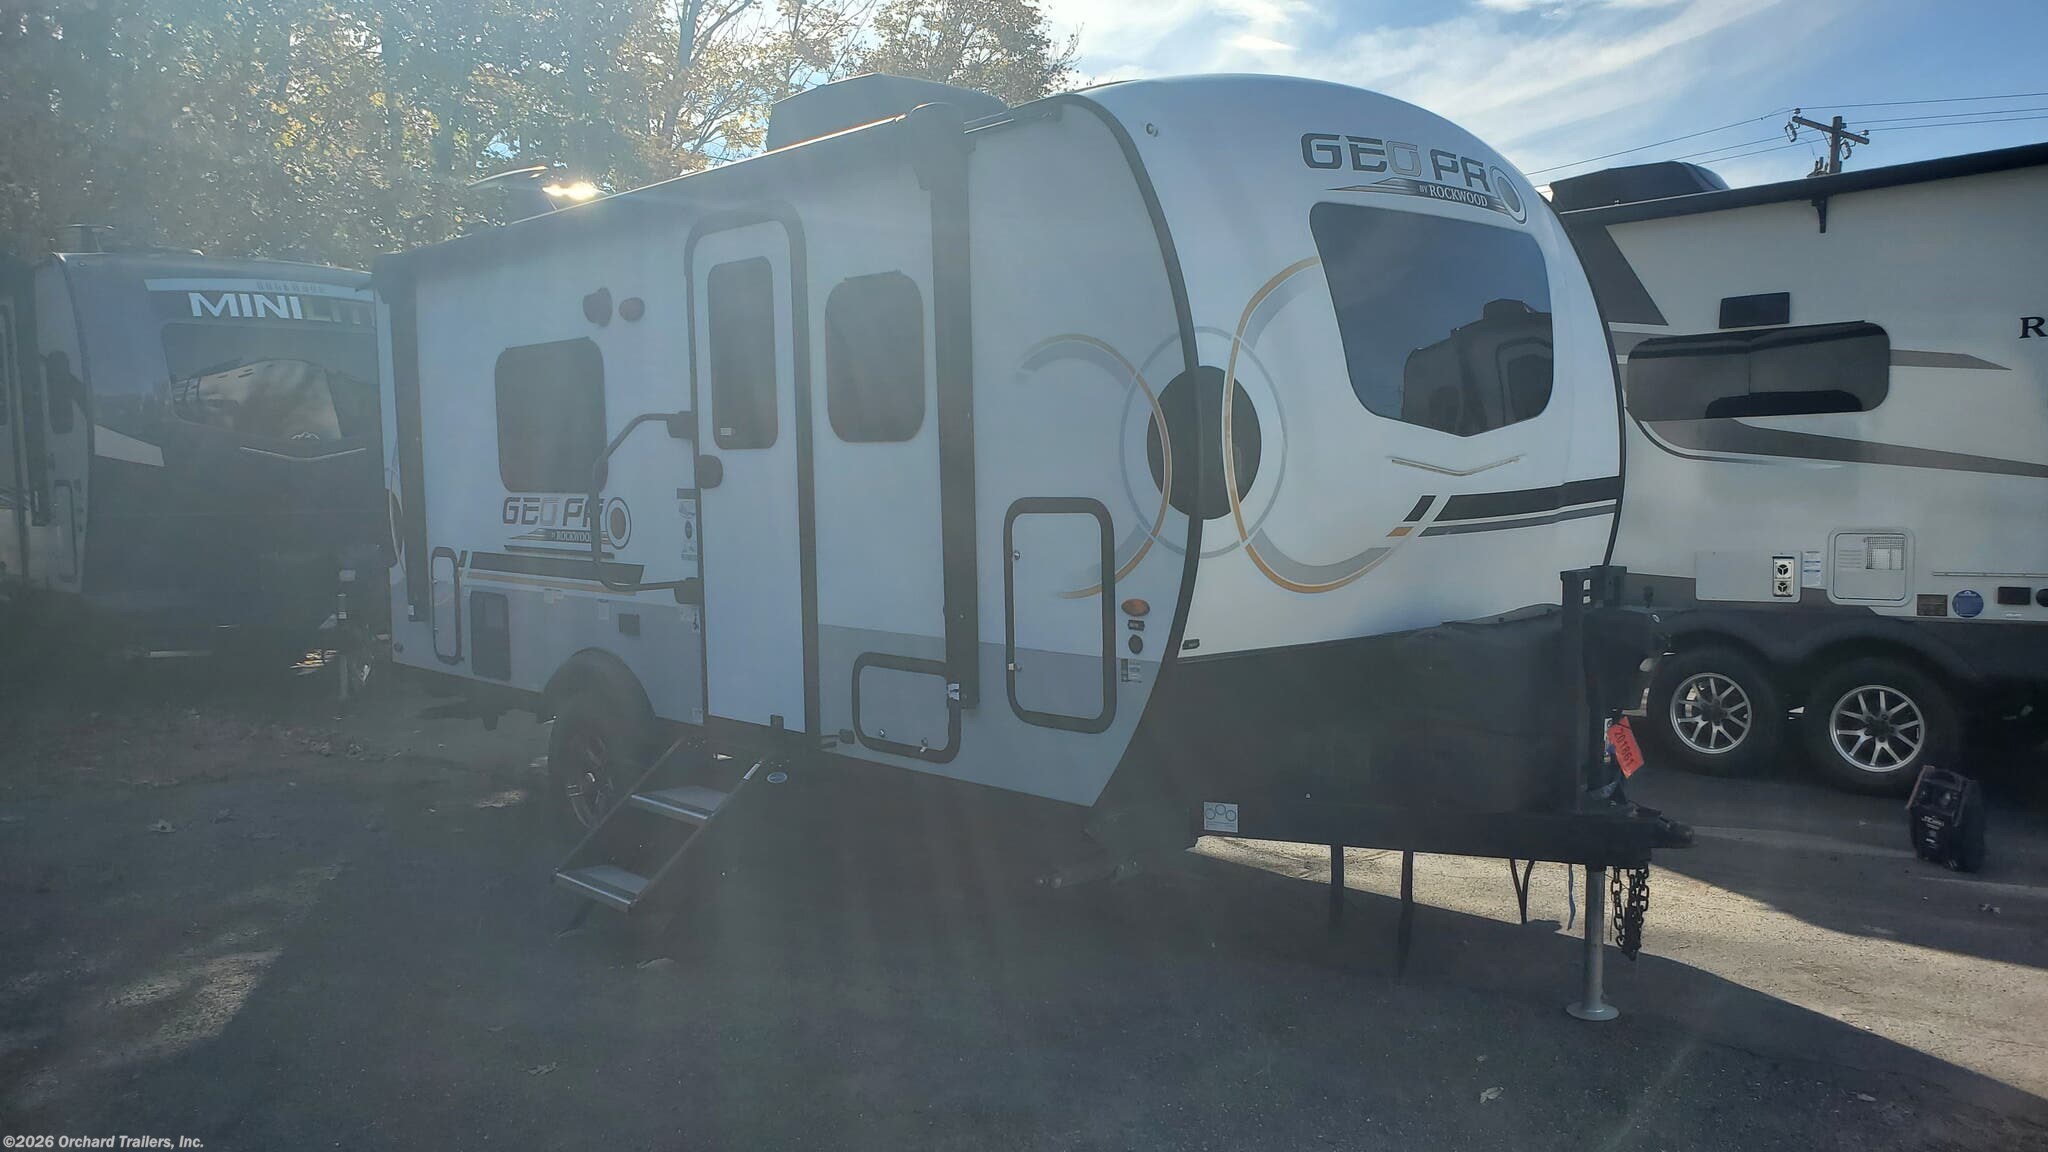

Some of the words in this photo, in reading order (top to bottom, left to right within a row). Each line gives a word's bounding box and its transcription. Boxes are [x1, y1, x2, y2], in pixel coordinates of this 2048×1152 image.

[1301, 133, 1422, 177] GEO
[1419, 185, 1429, 194] BY
[1429, 184, 1488, 208] ROCKWOOD
[188, 292, 303, 319] MINI
[502, 496, 560, 527] GEO
